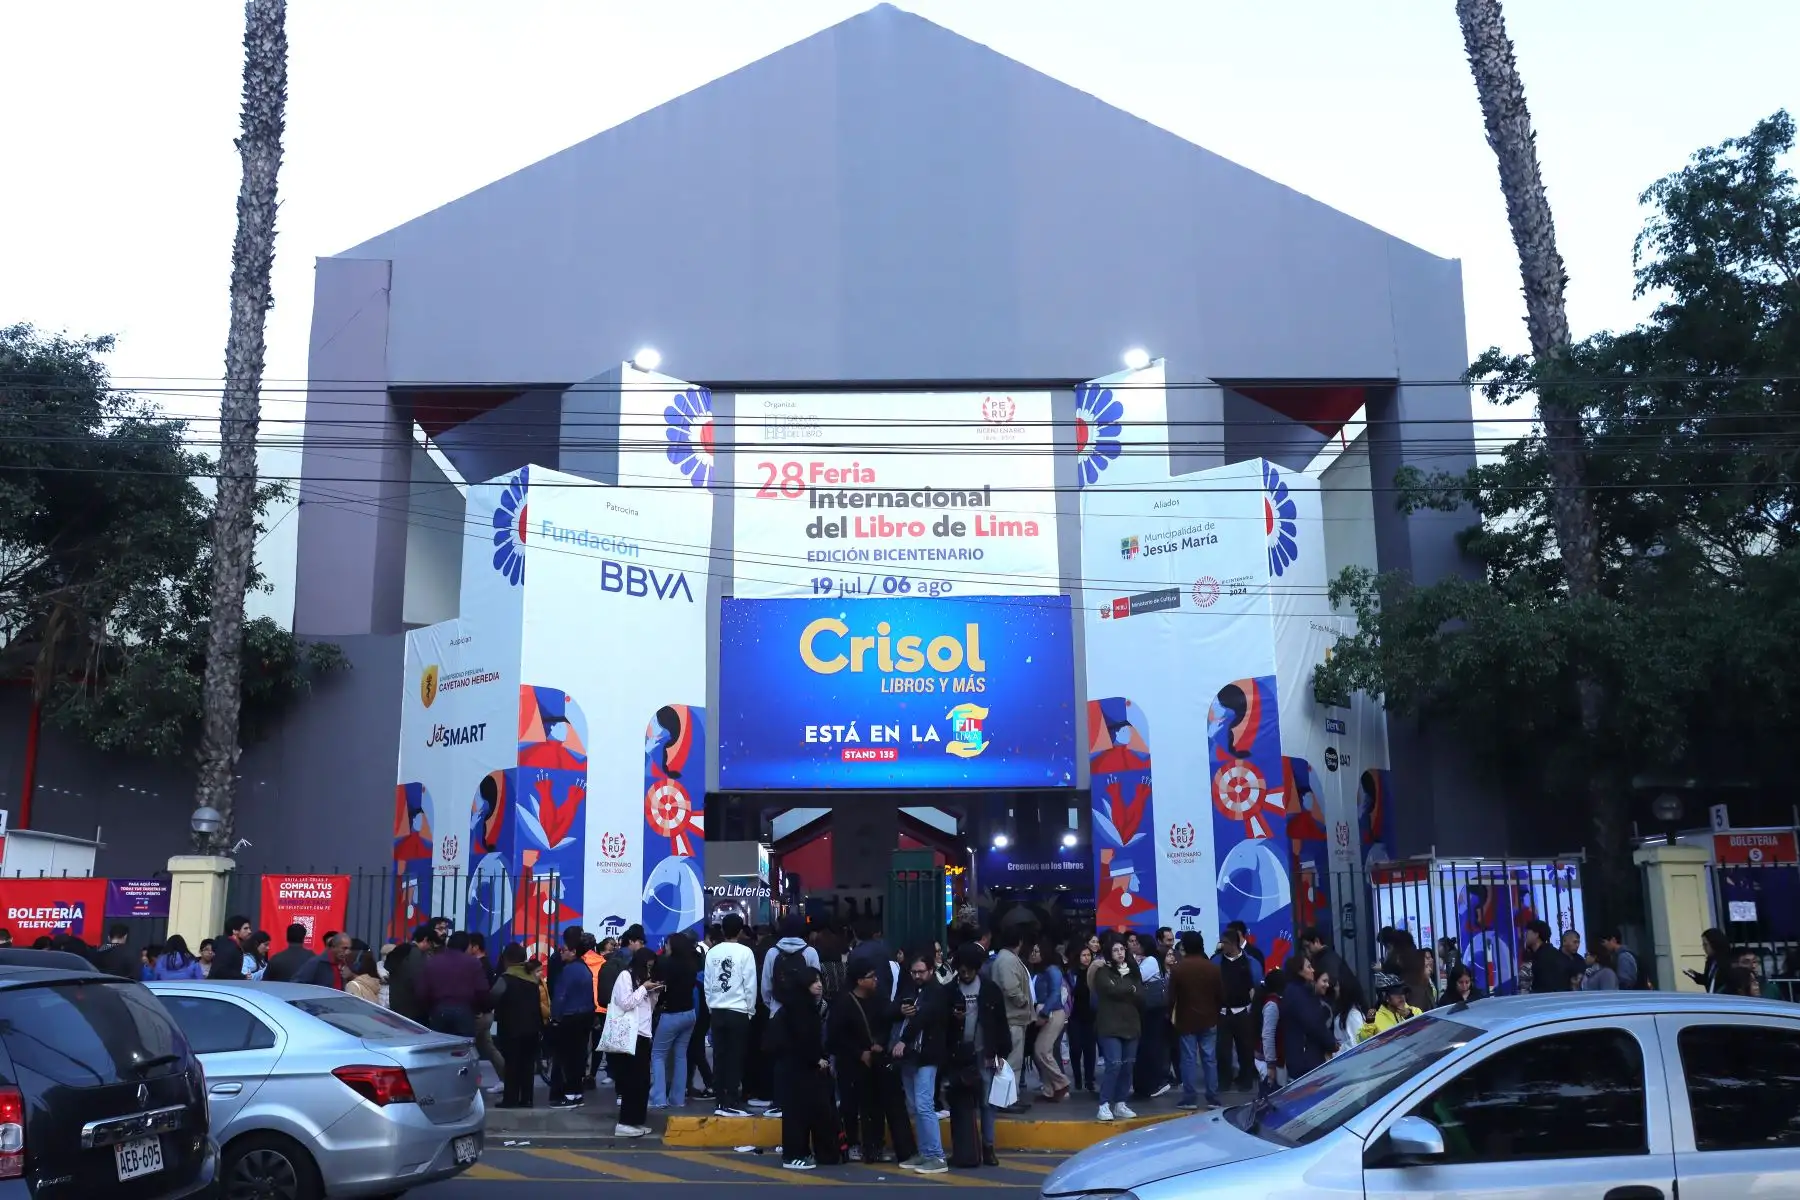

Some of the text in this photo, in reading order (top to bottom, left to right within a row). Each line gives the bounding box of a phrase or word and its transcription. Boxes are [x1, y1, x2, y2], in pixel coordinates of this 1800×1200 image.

[756, 461, 805, 499] 28
[809, 462, 876, 484] Feria
[809, 485, 991, 509] Internacional
[1153, 498, 1180, 511] Aliados
[606, 501, 639, 516] Patrocina
[806, 515, 1039, 539] del Libro de Lima
[1144, 521, 1215, 543] Municipalidad de
[542, 519, 639, 558] Fundación
[1143, 533, 1218, 558] Jesús María
[807, 547, 984, 562] EDICIÓN BICENTENARIO
[600, 560, 694, 603] BBVA
[811, 577, 833, 595] 19
[838, 576, 861, 598] jul
[883, 576, 911, 594] 06
[918, 580, 952, 598] ago
[1229, 588, 1247, 597] 2024
[800, 618, 986, 674] Crisol
[439, 671, 500, 692] CAYETANO HEREDIA
[881, 675, 986, 693] LIBROS Y MÁS
[805, 721, 940, 743] ESTÁ EN LA
[956, 719, 981, 732] FIL
[955, 732, 980, 741] LIMA
[844, 751, 895, 759] STAND 135
[1715, 809, 1723, 827] 5
[1166, 851, 1202, 859] BICENTENARIO
[1051, 861, 1062, 870] los
[1062, 861, 1084, 870] libros
[280, 882, 315, 890] COMPRA
[280, 890, 332, 899] ENTRADAS
[8, 905, 83, 919] BOLETERÍA
[1180, 916, 1195, 925] FIL
[605, 926, 620, 935] FIL
[120, 1145, 160, 1174] AEB-695
